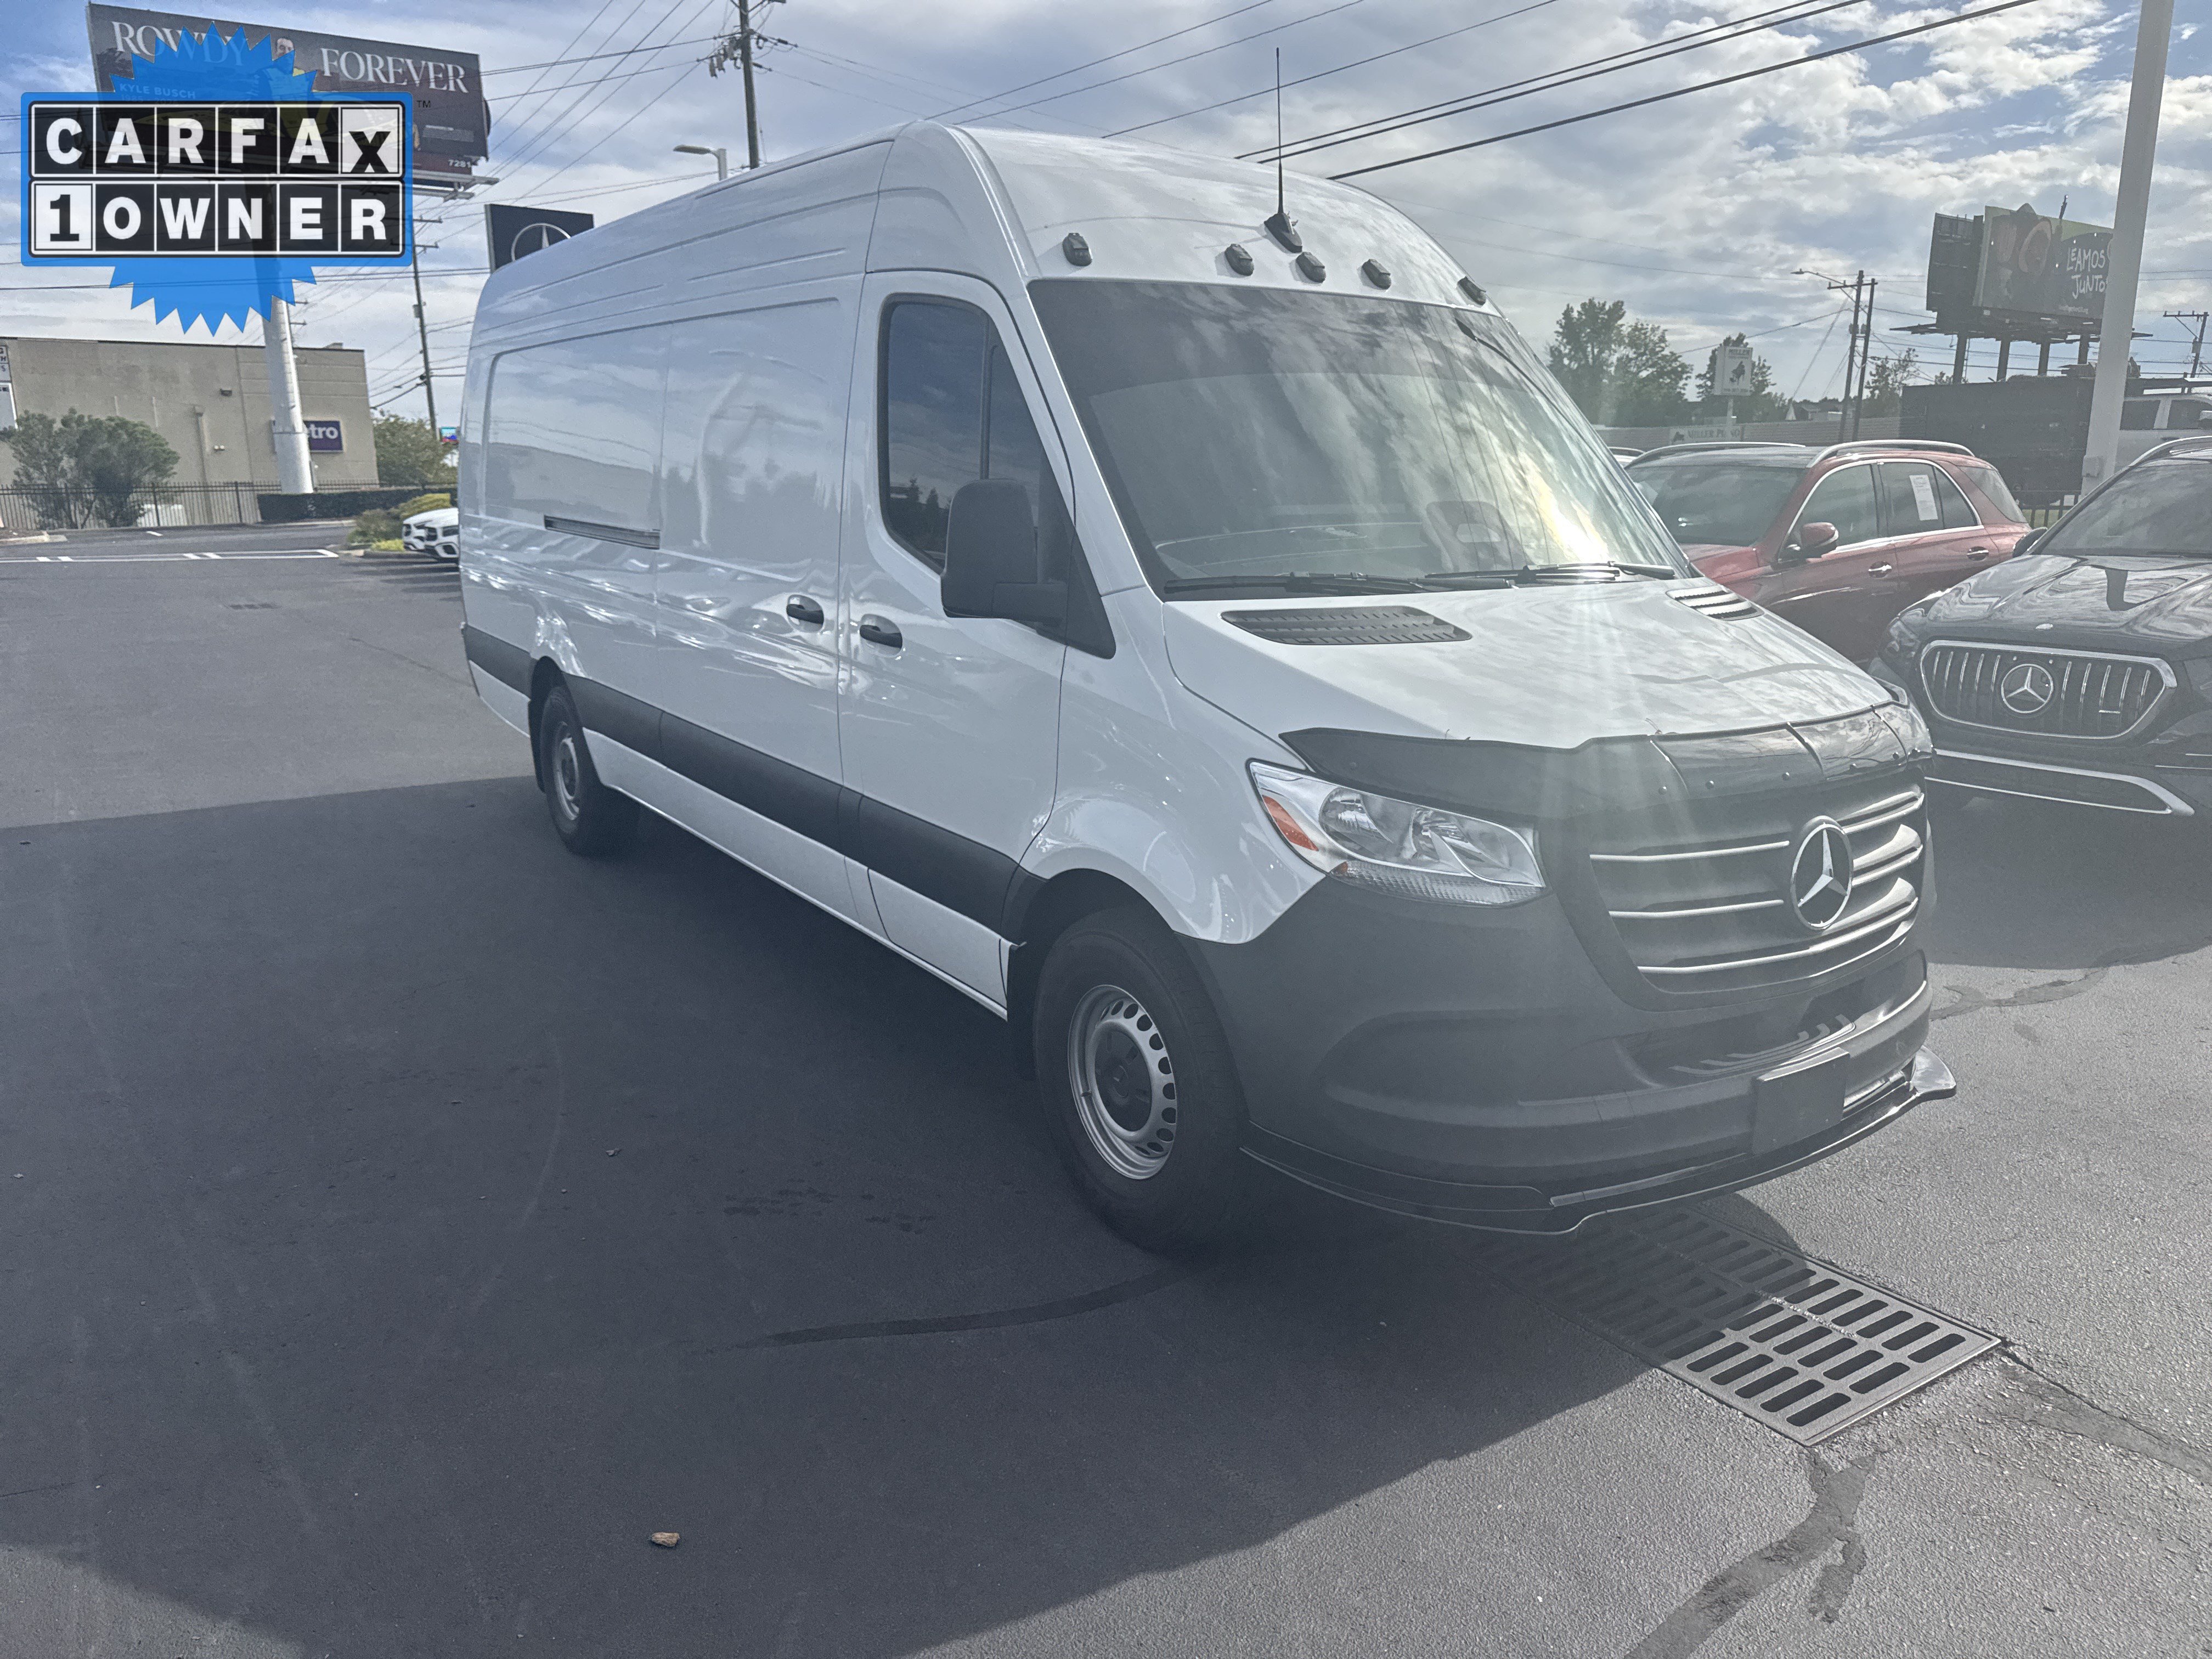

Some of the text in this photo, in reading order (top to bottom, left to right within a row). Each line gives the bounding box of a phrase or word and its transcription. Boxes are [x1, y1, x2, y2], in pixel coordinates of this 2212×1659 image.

[112, 21, 469, 93] ROWDY FOREVER
[120, 83, 196, 99] KYLE BUSCH
[2067, 247, 2106, 272] LEAMOS
[2071, 274, 2108, 299] JUNTO
[307, 424, 338, 439] tro
